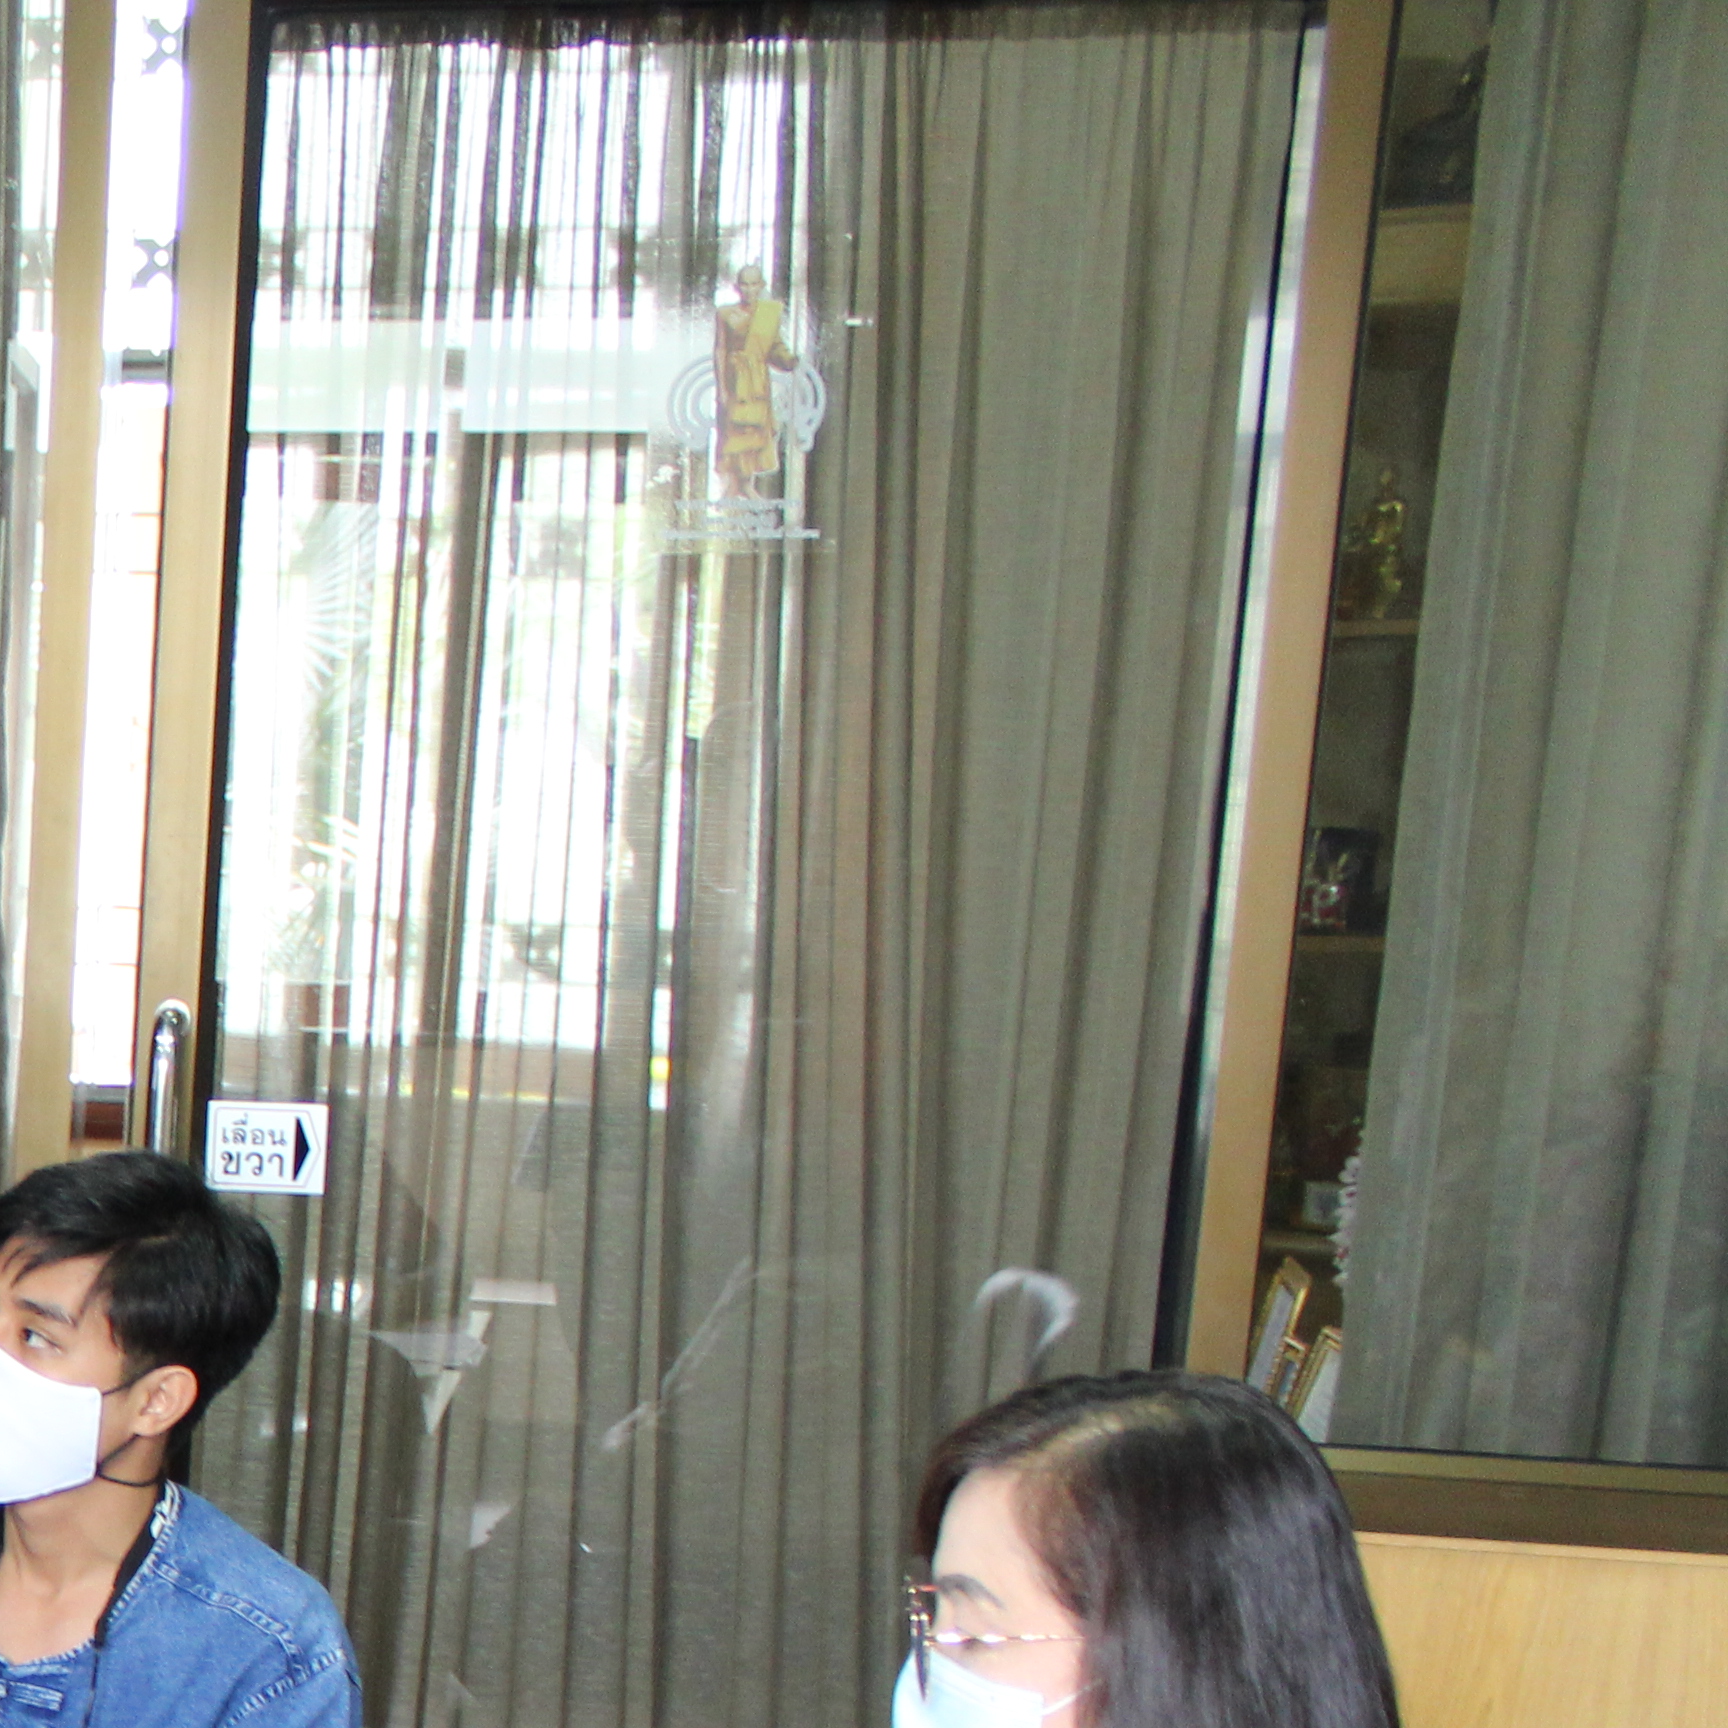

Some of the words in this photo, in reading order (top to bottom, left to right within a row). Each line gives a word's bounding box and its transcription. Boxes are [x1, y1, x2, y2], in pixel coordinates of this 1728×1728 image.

[220, 1111, 288, 1146] เลื่อน
[219, 1149, 285, 1178] ขวา
